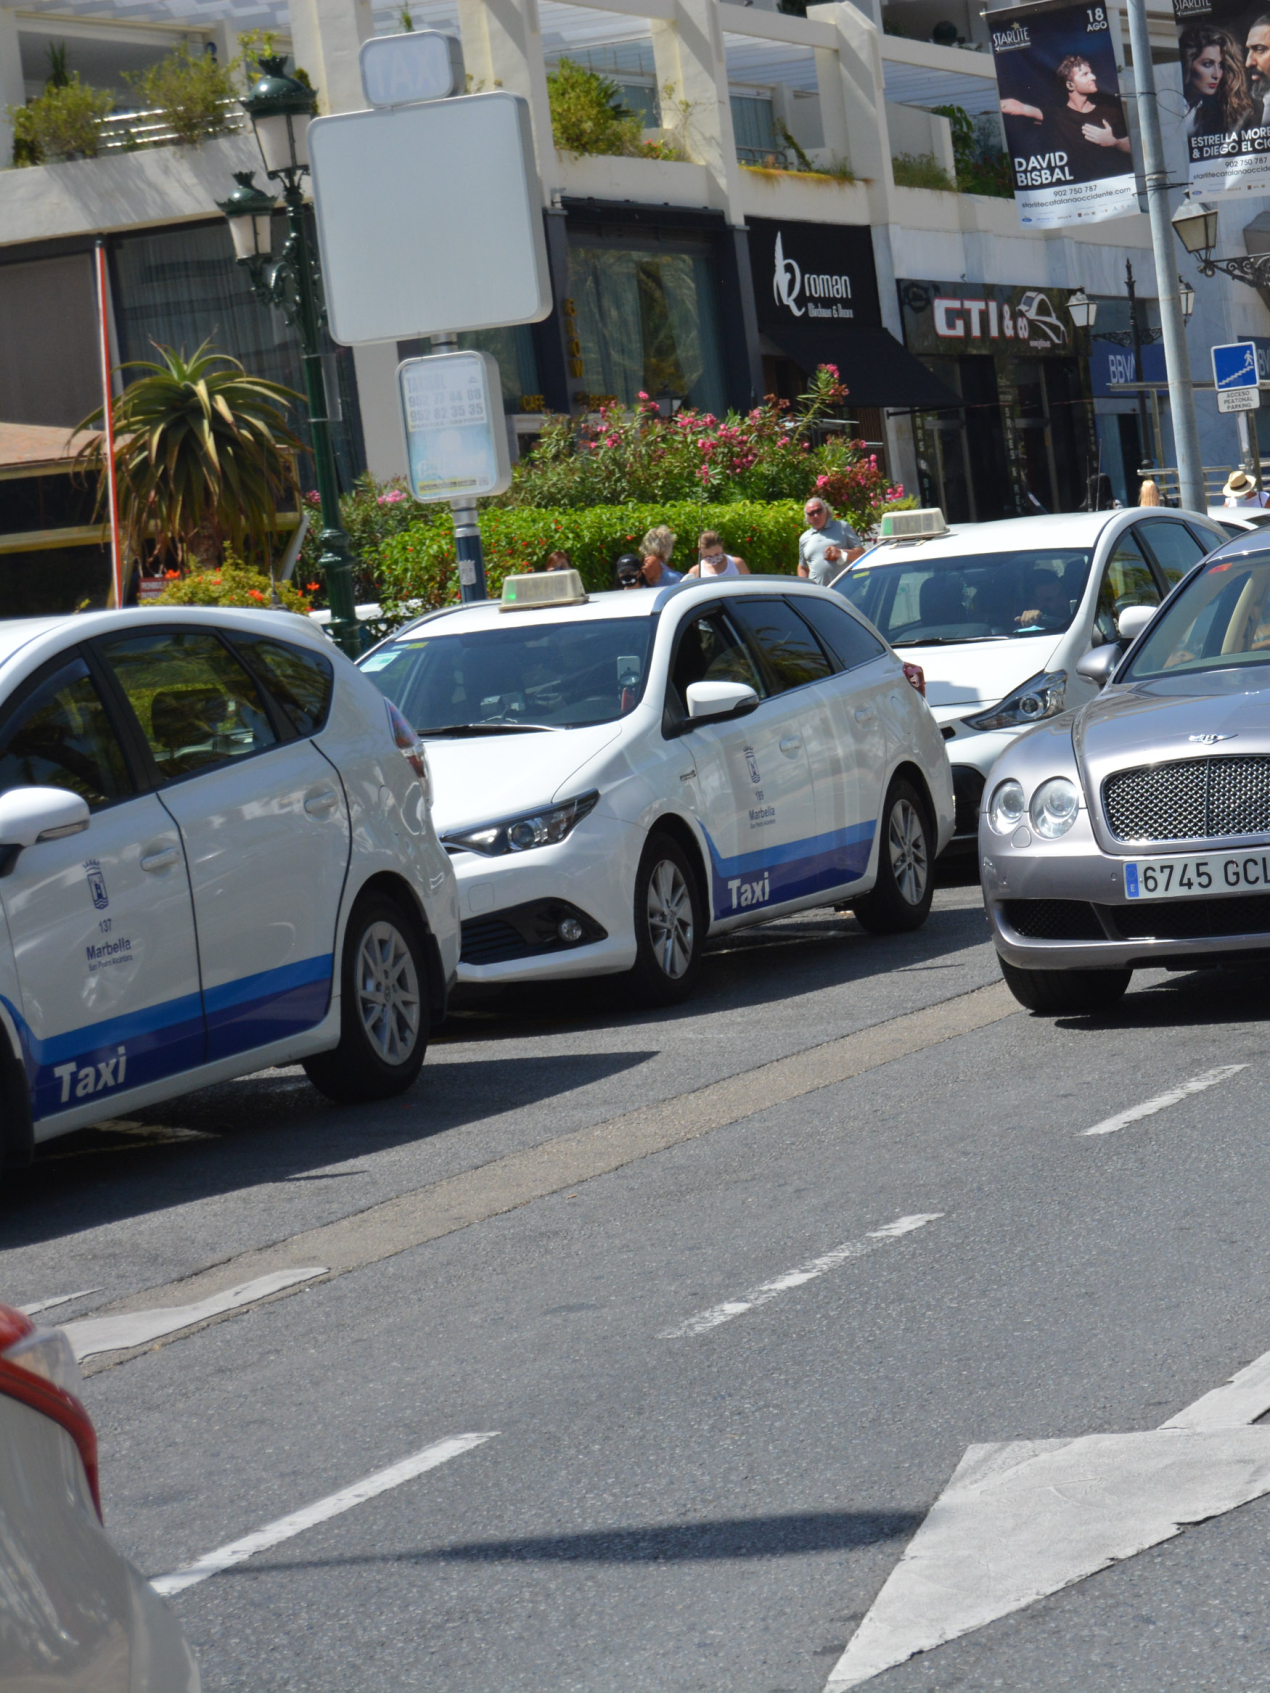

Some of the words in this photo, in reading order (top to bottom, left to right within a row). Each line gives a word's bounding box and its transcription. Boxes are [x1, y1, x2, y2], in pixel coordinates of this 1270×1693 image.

[1086, 8, 1104, 22] 18
[1086, 21, 1108, 32] AGO
[992, 27, 1030, 46] STARLITE
[1191, 131, 1238, 148] ESTRELLA
[1192, 148, 1200, 159] &
[1203, 142, 1238, 158] DIEGO
[1242, 142, 1253, 152] EL
[1014, 152, 1068, 172] DAVID
[1225, 160, 1238, 168] 902
[1240, 159, 1252, 167] 750
[1016, 166, 1074, 186] BISBAL
[1054, 189, 1068, 198] 902
[1070, 188, 1082, 196] 750
[1084, 184, 1098, 192] 787
[804, 274, 852, 298] roman
[934, 297, 999, 339] GTI
[1003, 303, 1014, 339] &
[1224, 397, 1254, 405] PEATONAL
[1226, 390, 1250, 399] ACCESO
[468, 402, 484, 416] 35
[1226, 403, 1252, 411] PARKING
[749, 806, 775, 821] Marbella
[1143, 862, 1212, 892] 6745
[728, 872, 770, 910] Taxi
[1130, 884, 1136, 892] E
[99, 918, 112, 933] 137
[86, 938, 132, 960] Marbella
[54, 1046, 126, 1103] Taxi
